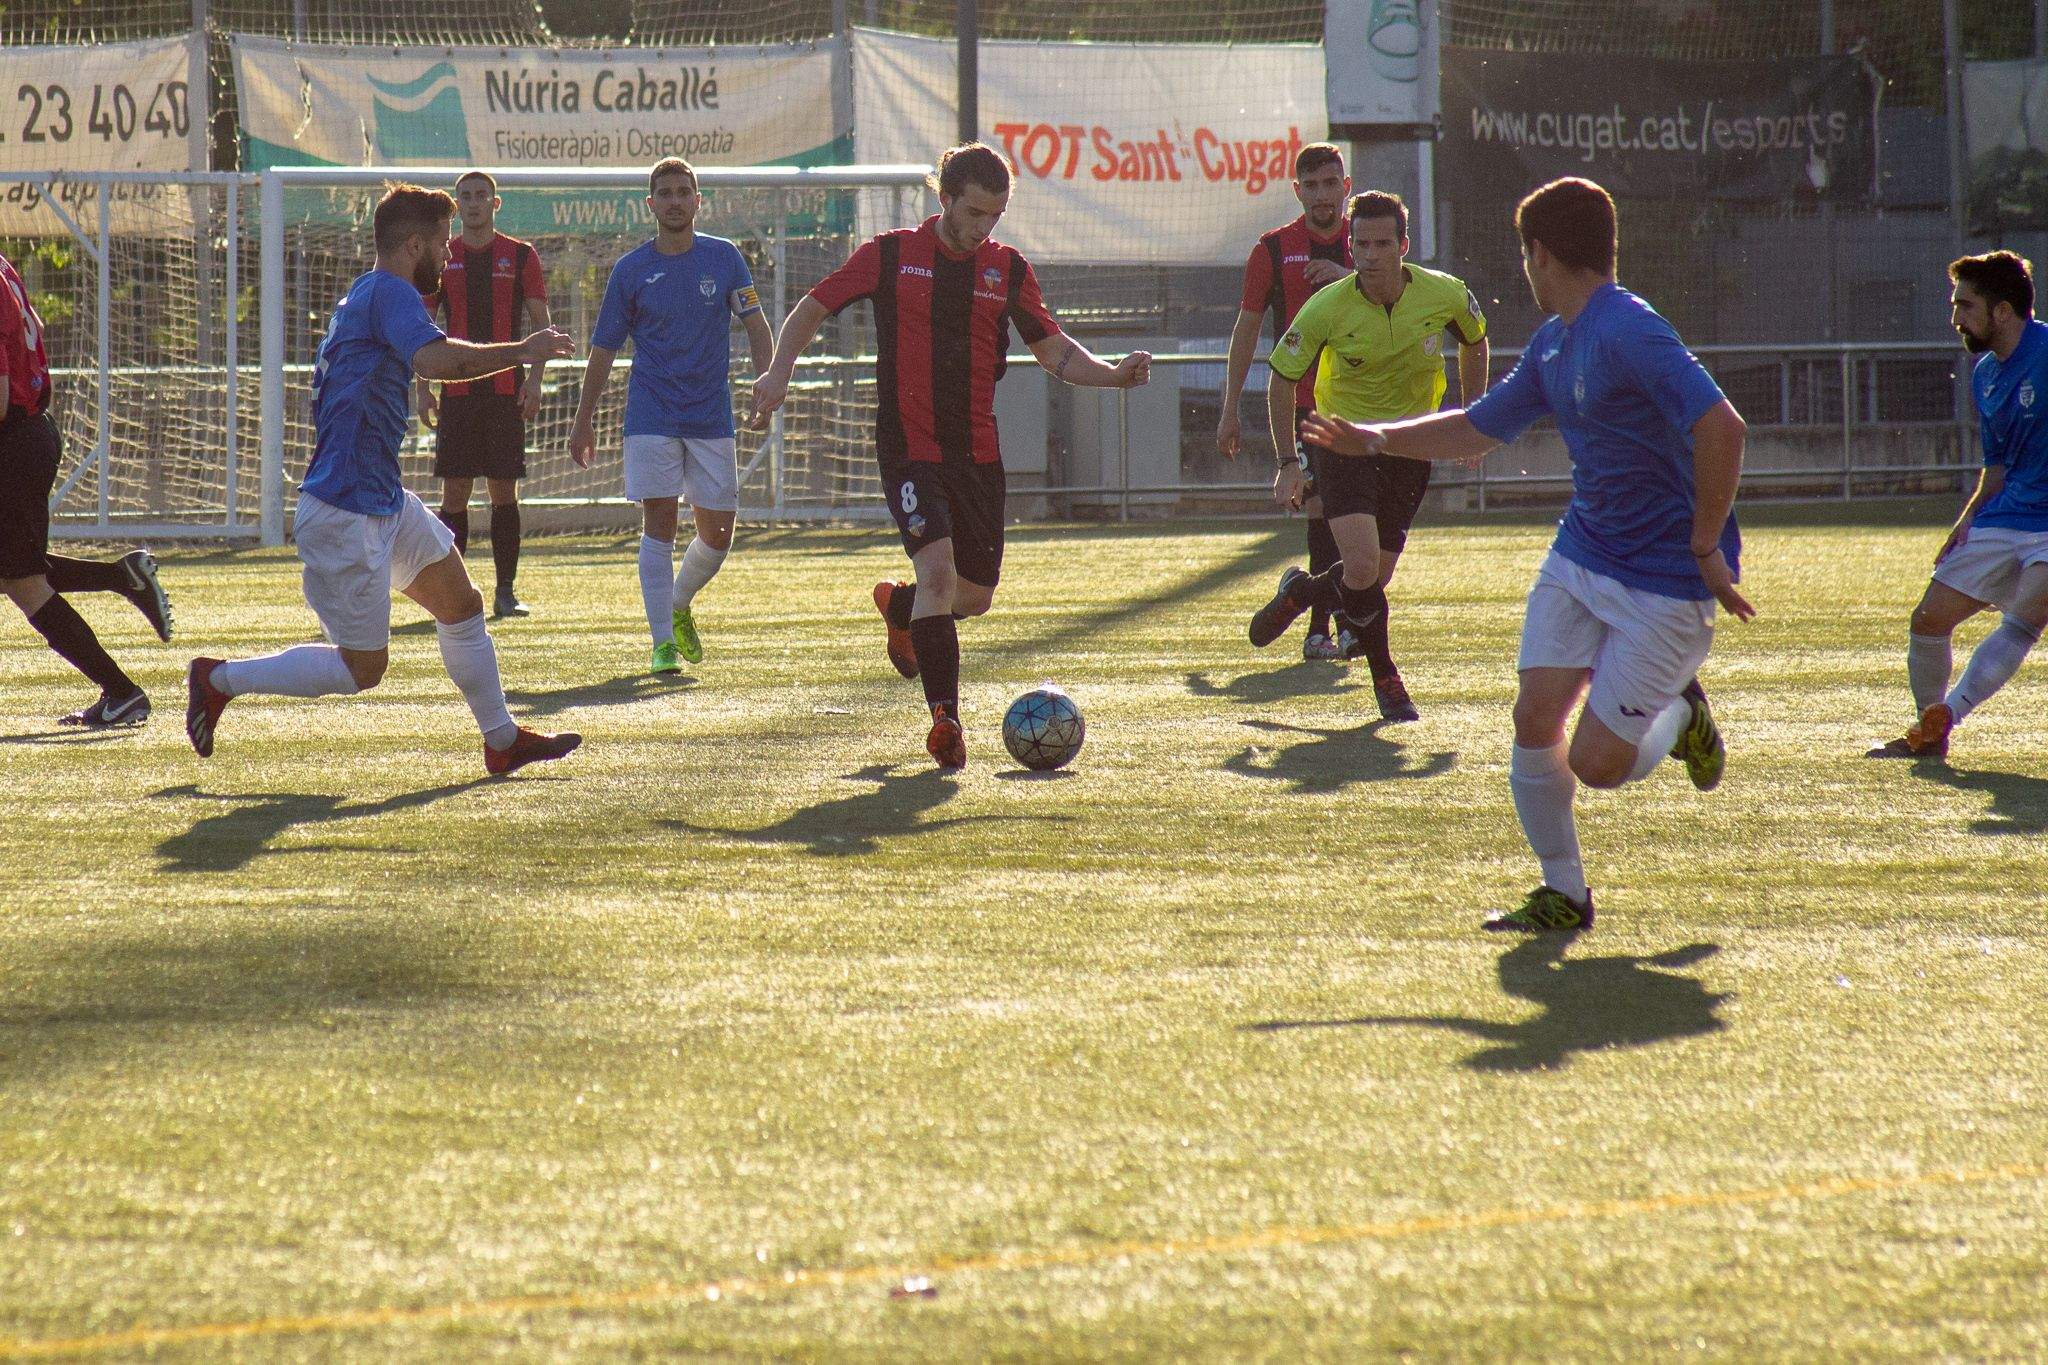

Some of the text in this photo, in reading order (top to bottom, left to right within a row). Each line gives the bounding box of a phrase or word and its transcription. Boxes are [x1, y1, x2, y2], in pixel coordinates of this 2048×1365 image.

[18, 81, 190, 142] 23 40 40
[485, 66, 719, 114] Núria Caballé
[494, 124, 735, 166] Fisioteràpia i Osteopatia
[1471, 100, 1848, 162] www.cugat.cat/esports
[994, 123, 1303, 195] TOT Sant Cugat
[901, 481, 918, 513] 8
